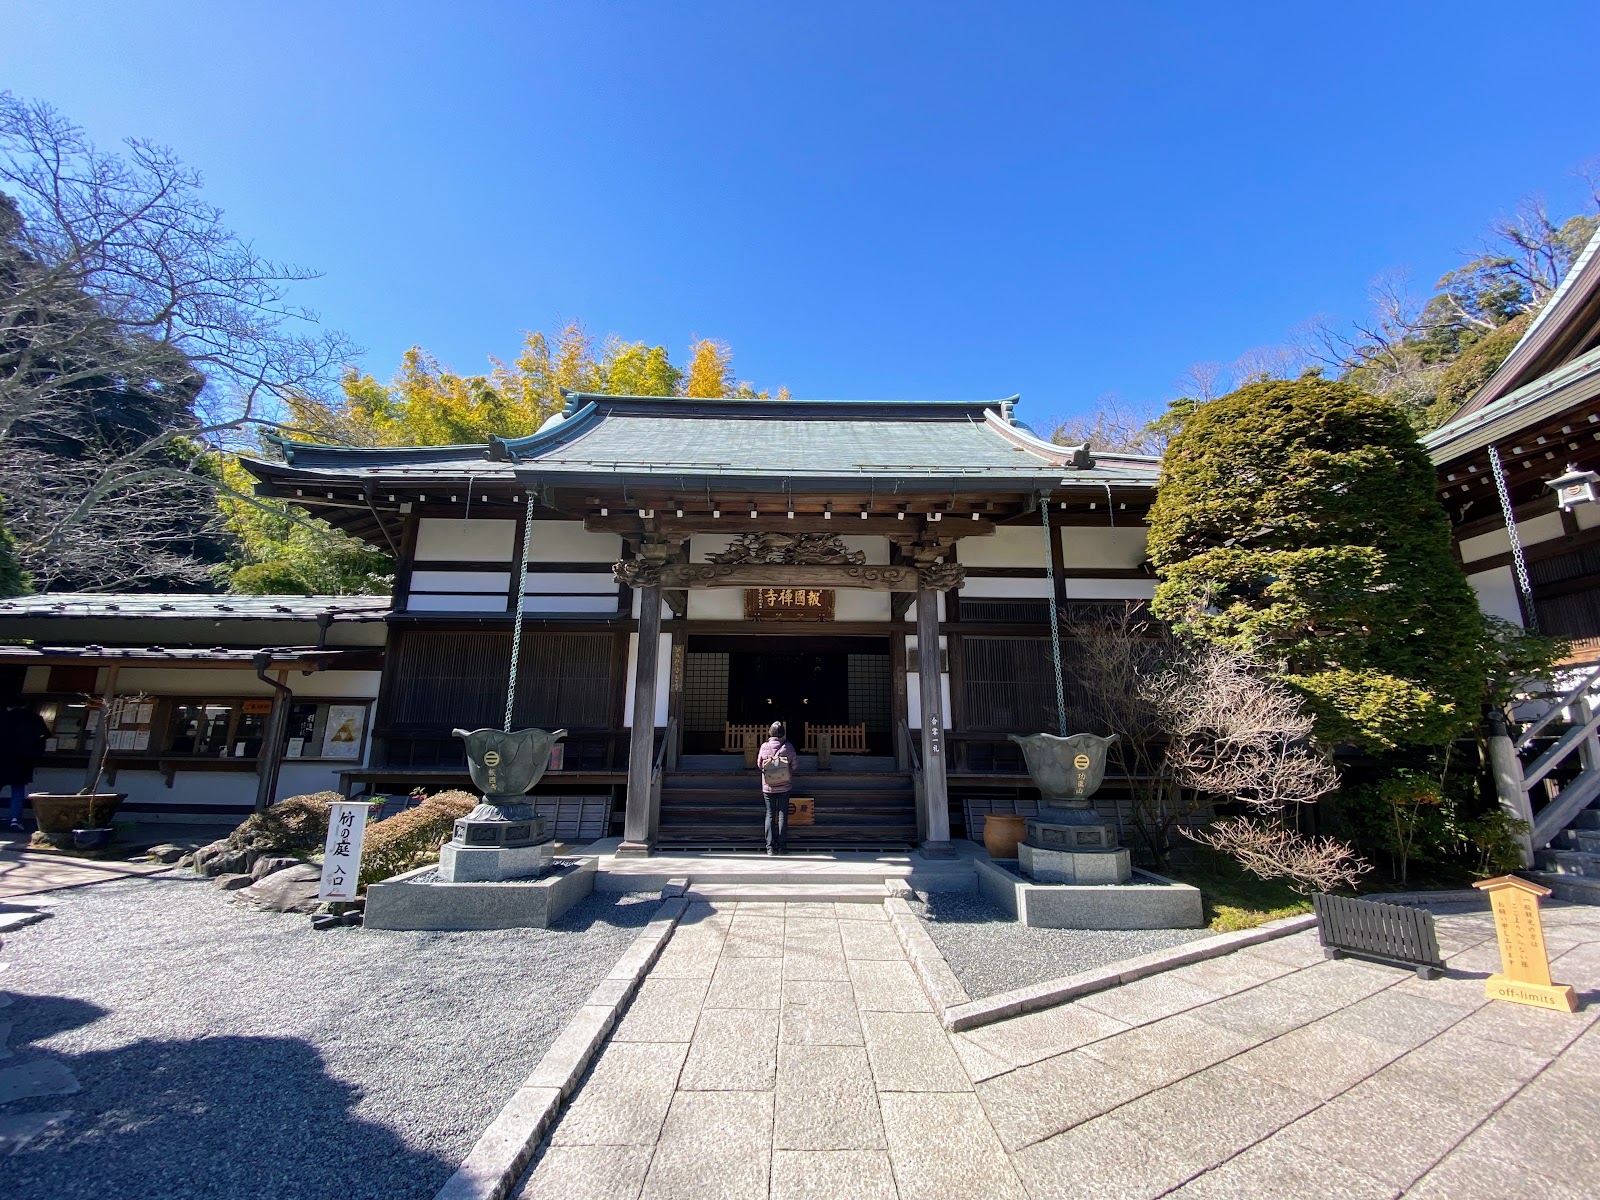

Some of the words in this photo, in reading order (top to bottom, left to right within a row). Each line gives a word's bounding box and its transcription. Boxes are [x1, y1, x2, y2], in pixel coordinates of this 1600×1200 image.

[931, 717, 940, 752] 合掌一礼
[333, 811, 355, 857] 竹の庭
[333, 864, 346, 886] 入口
[1498, 987, 1555, 1005] off-limits
